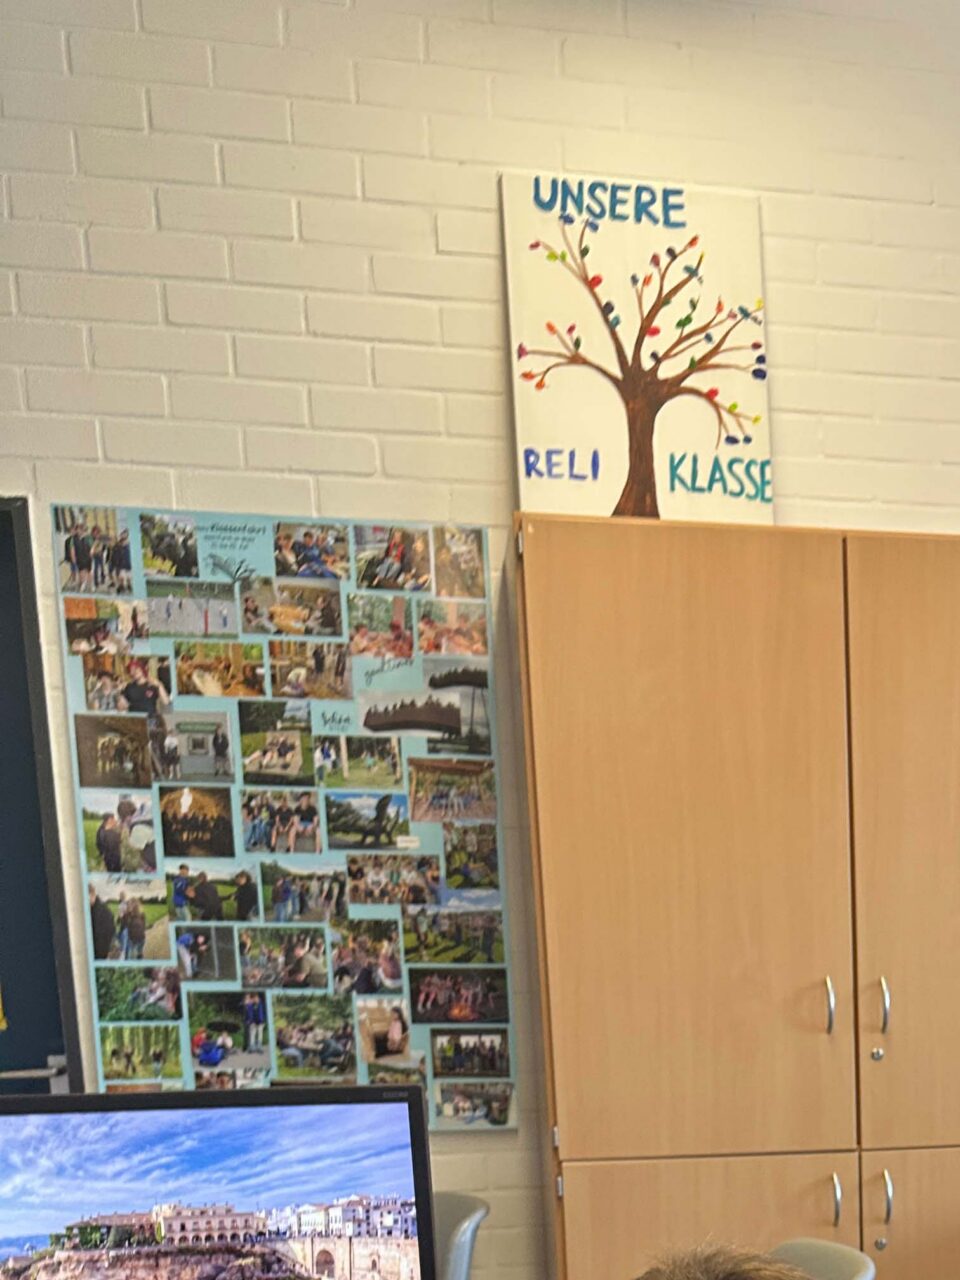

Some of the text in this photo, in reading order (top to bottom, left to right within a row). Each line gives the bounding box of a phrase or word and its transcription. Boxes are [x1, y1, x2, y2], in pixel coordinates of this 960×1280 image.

[533, 175, 687, 228] UNSERE
[522, 448, 773, 503] RELI KLASSE
